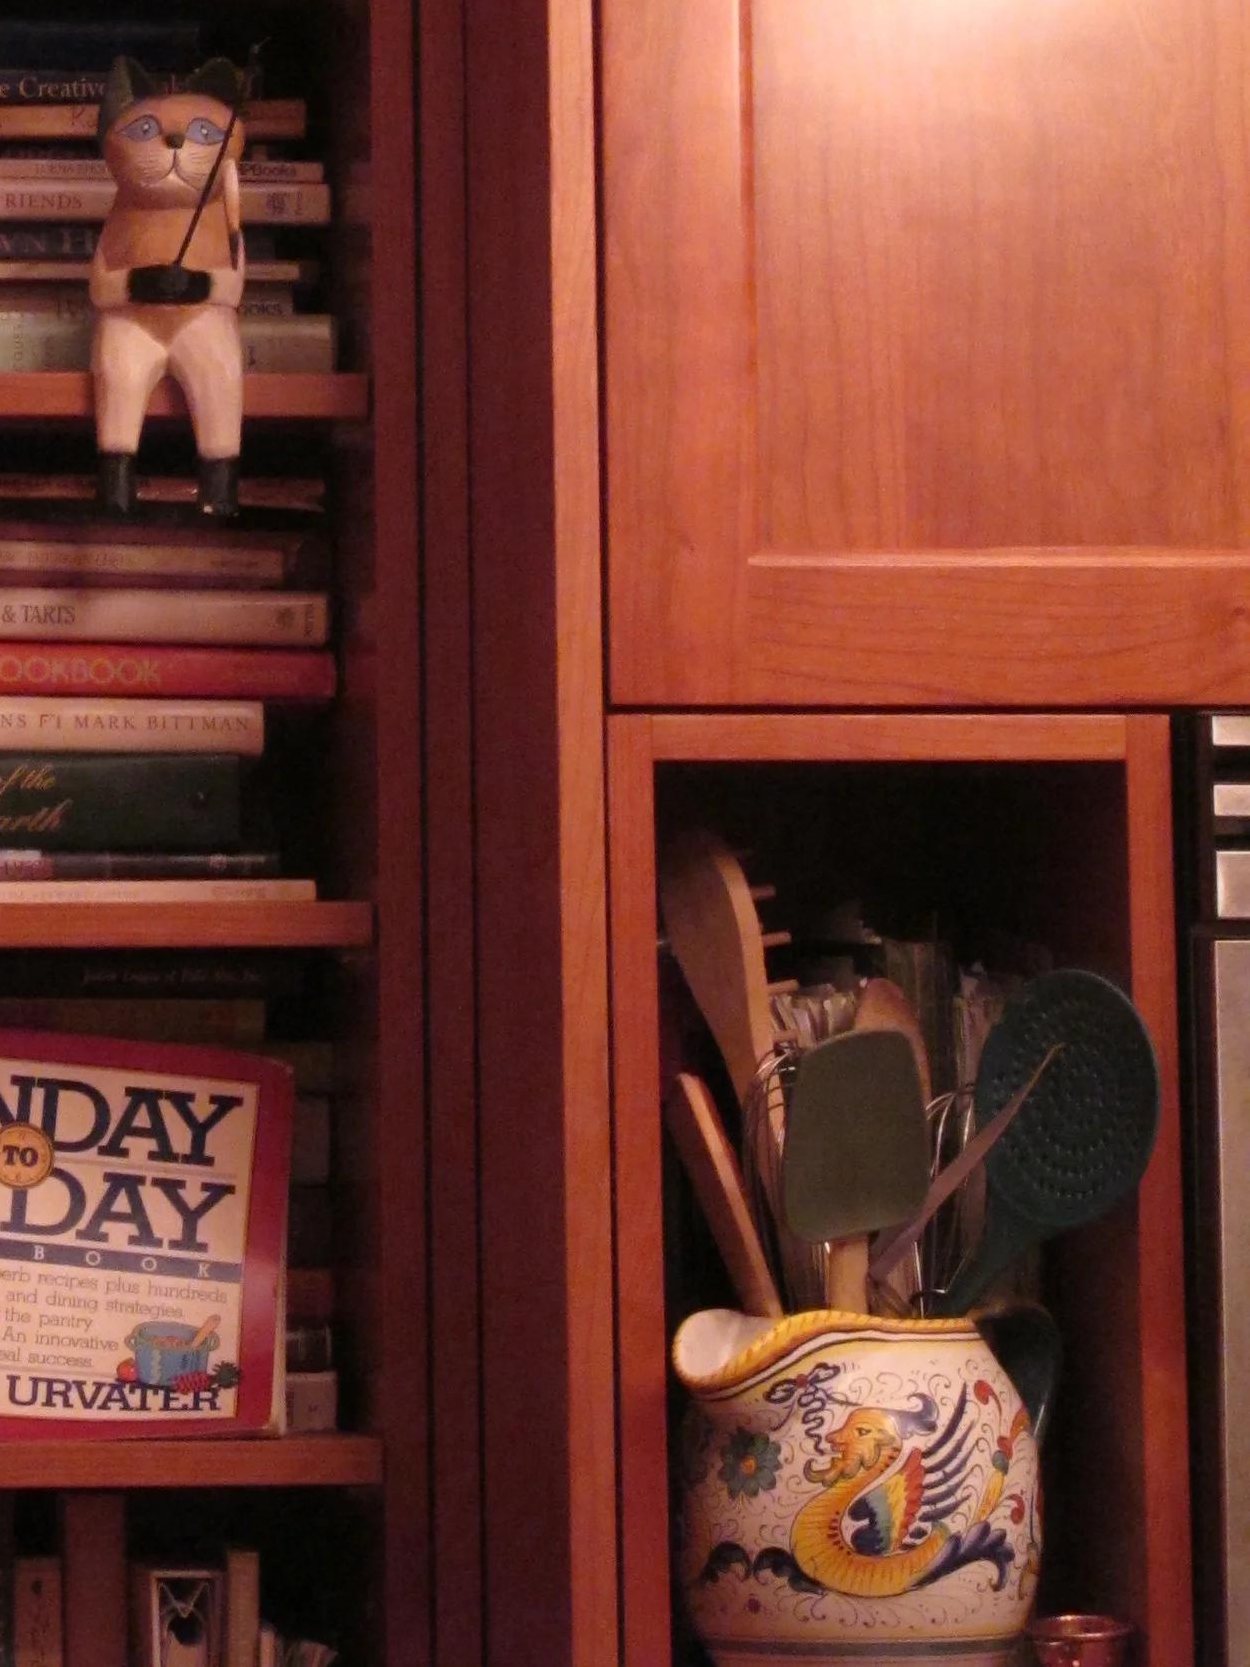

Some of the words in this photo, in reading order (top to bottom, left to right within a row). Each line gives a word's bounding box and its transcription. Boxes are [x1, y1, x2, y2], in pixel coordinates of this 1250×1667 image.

[1, 604, 17, 624] &
[20, 604, 76, 625] TARTS
[74, 714, 136, 730] MARK
[147, 715, 249, 732] BITTMAN
[19, 766, 56, 791] the
[1, 1144, 40, 1167] TO
[37, 1267, 98, 1291] recipes
[104, 1276, 140, 1296] plus
[147, 1280, 227, 1303] hundreds
[5, 1285, 38, 1304] and
[45, 1290, 98, 1311] dining
[104, 1299, 185, 1319] strategies.
[4, 1308, 31, 1324] the
[38, 1312, 93, 1336] pantry
[1, 1326, 27, 1344] An
[34, 1330, 119, 1353] innovative
[27, 1352, 95, 1369] success.
[6, 1372, 221, 1413] URVATER
